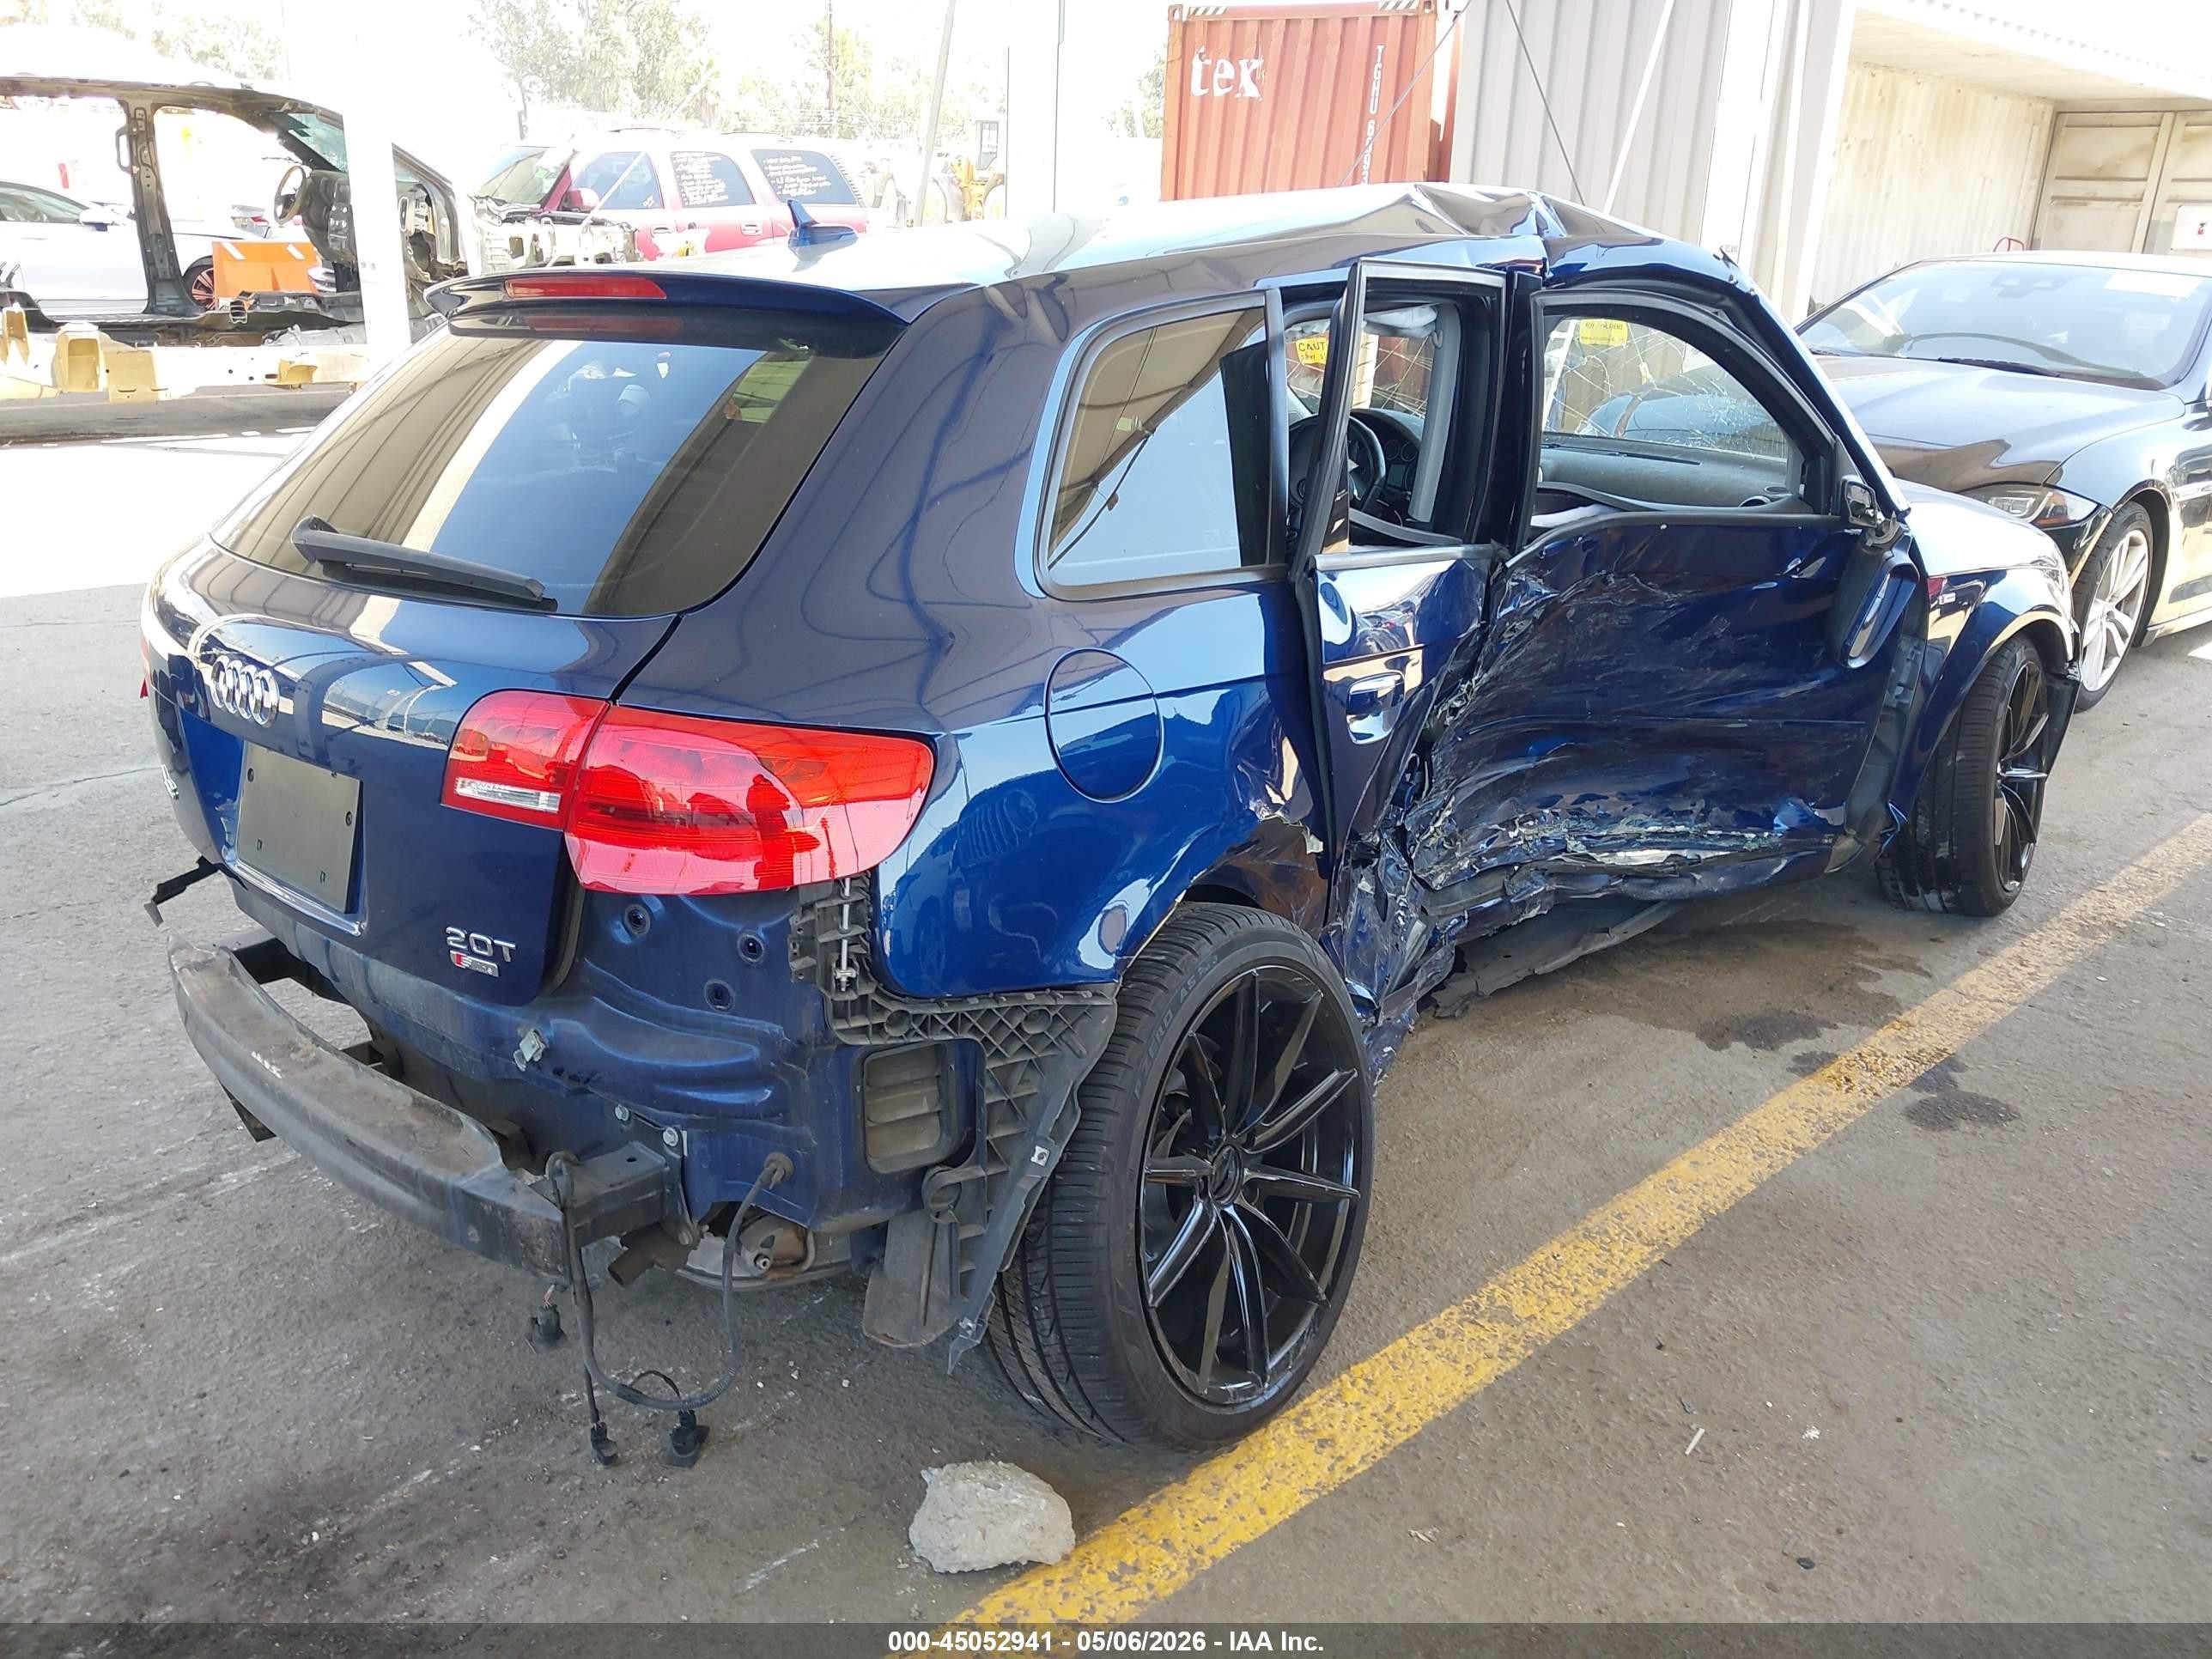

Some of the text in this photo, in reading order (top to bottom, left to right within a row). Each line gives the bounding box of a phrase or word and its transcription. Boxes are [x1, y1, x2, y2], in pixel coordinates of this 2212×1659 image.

[1190, 45, 1265, 100] tex
[1369, 45, 1384, 114] TGHU
[1298, 341, 1326, 352] CAUT
